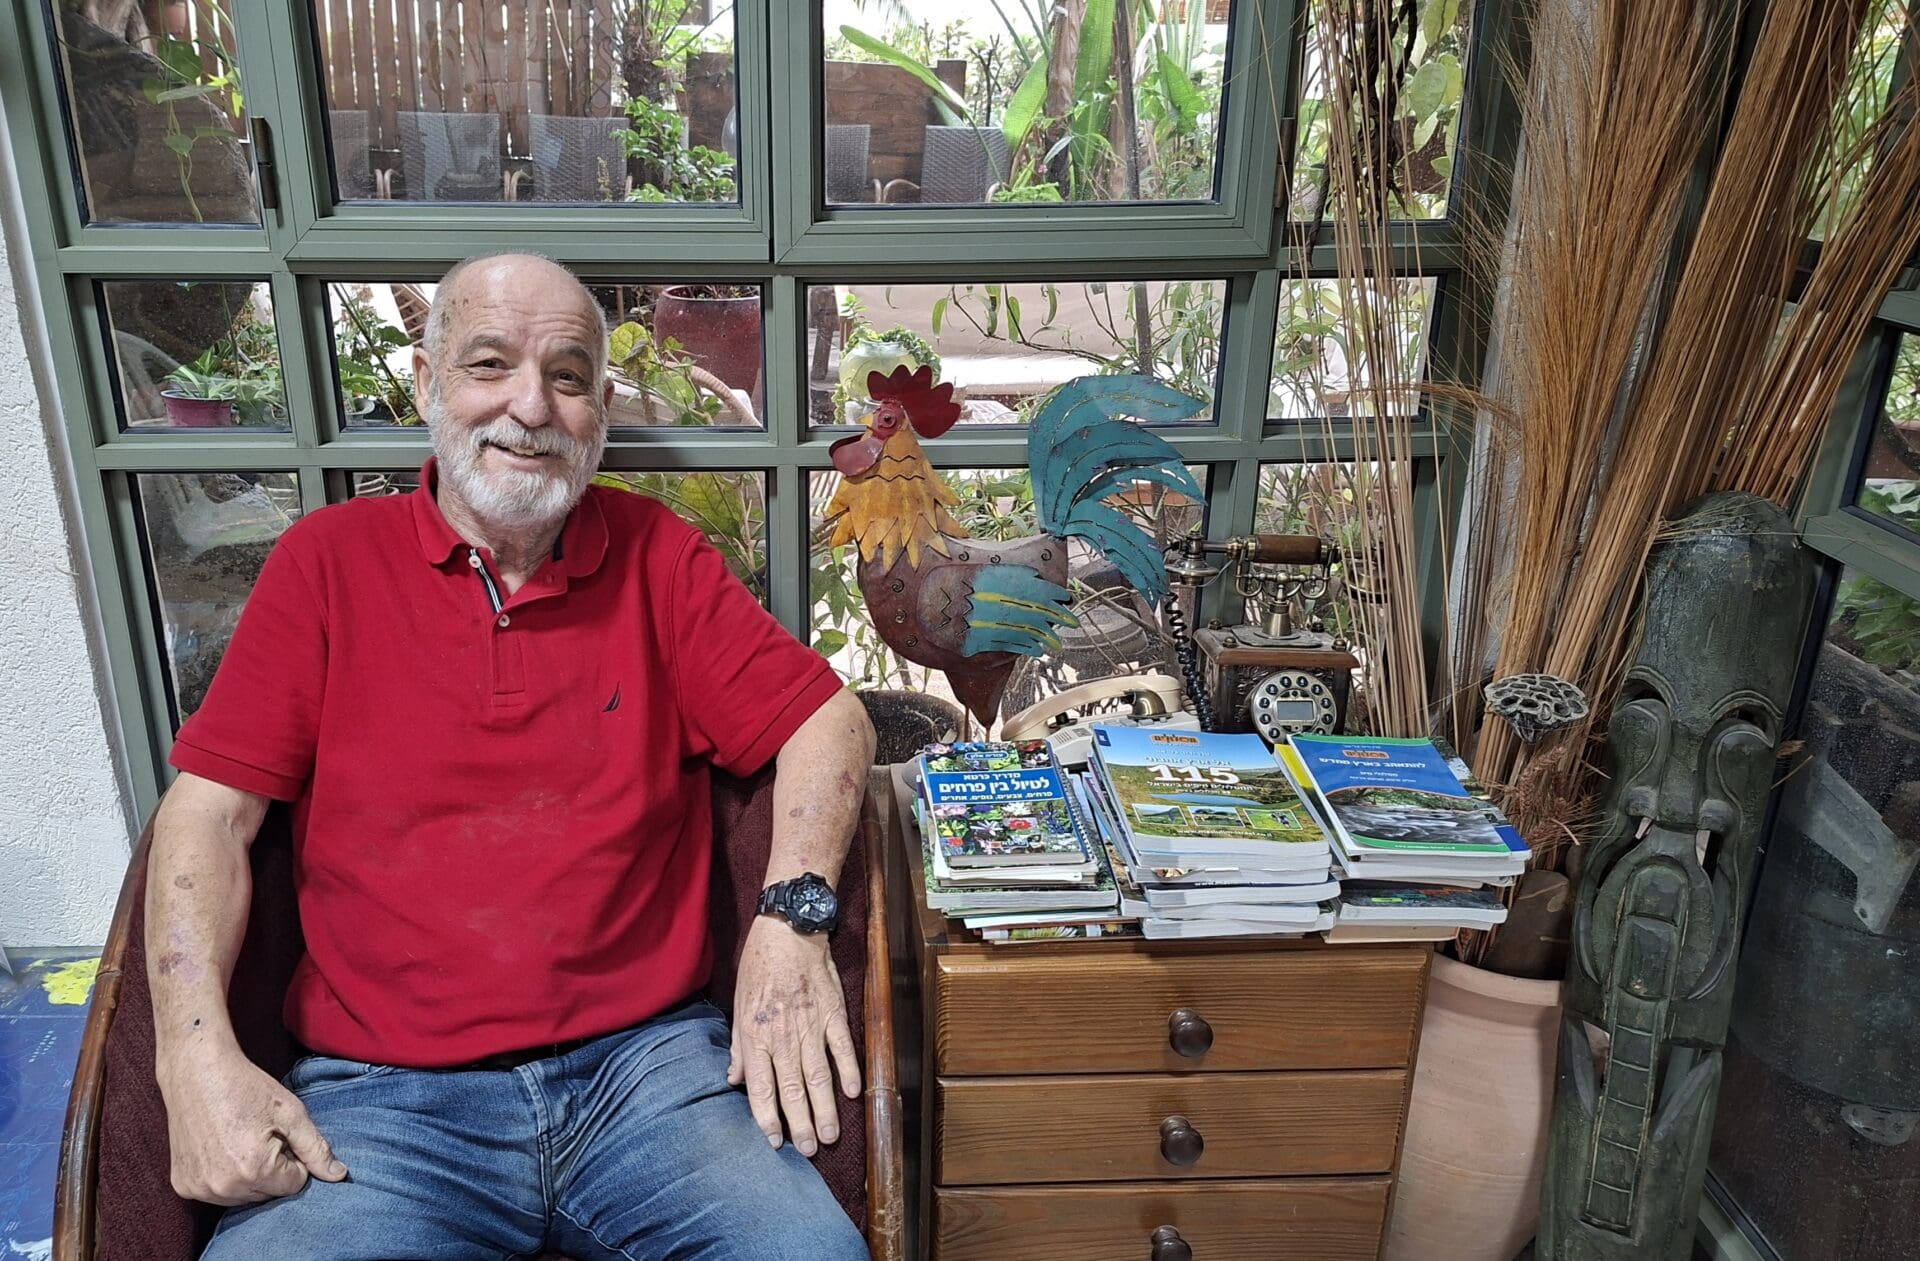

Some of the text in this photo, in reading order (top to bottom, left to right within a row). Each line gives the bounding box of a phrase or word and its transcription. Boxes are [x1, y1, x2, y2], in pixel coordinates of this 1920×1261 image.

[1319, 757, 1351, 765] מחדש
[1353, 760, 1381, 768] בארץ
[1147, 764, 1240, 784] 115
[939, 776, 1050, 794] לטיול בין פרחים
